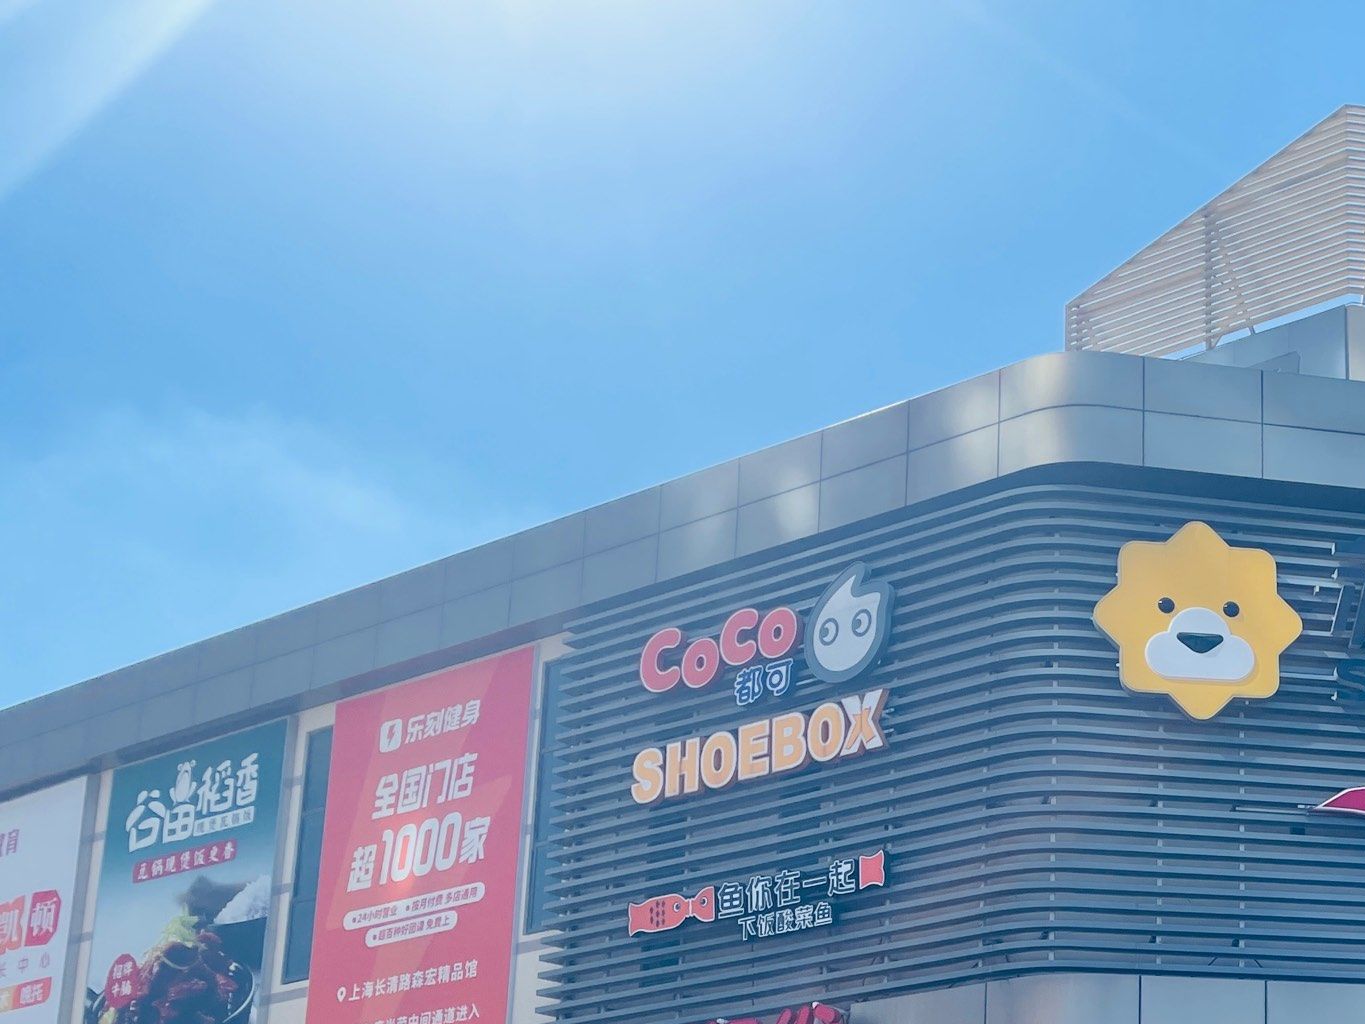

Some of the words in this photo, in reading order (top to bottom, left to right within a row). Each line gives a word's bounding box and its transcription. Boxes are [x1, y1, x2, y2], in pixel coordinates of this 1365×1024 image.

[640, 607, 798, 693] CoCo
[734, 657, 795, 705] 都可
[405, 700, 480, 744] 乐刻健身
[630, 689, 890, 805] SHOEBOX
[372, 752, 478, 819] 全国门店
[718, 859, 857, 920] 鱼你在一起
[738, 903, 833, 940] 下饭酸菜鱼
